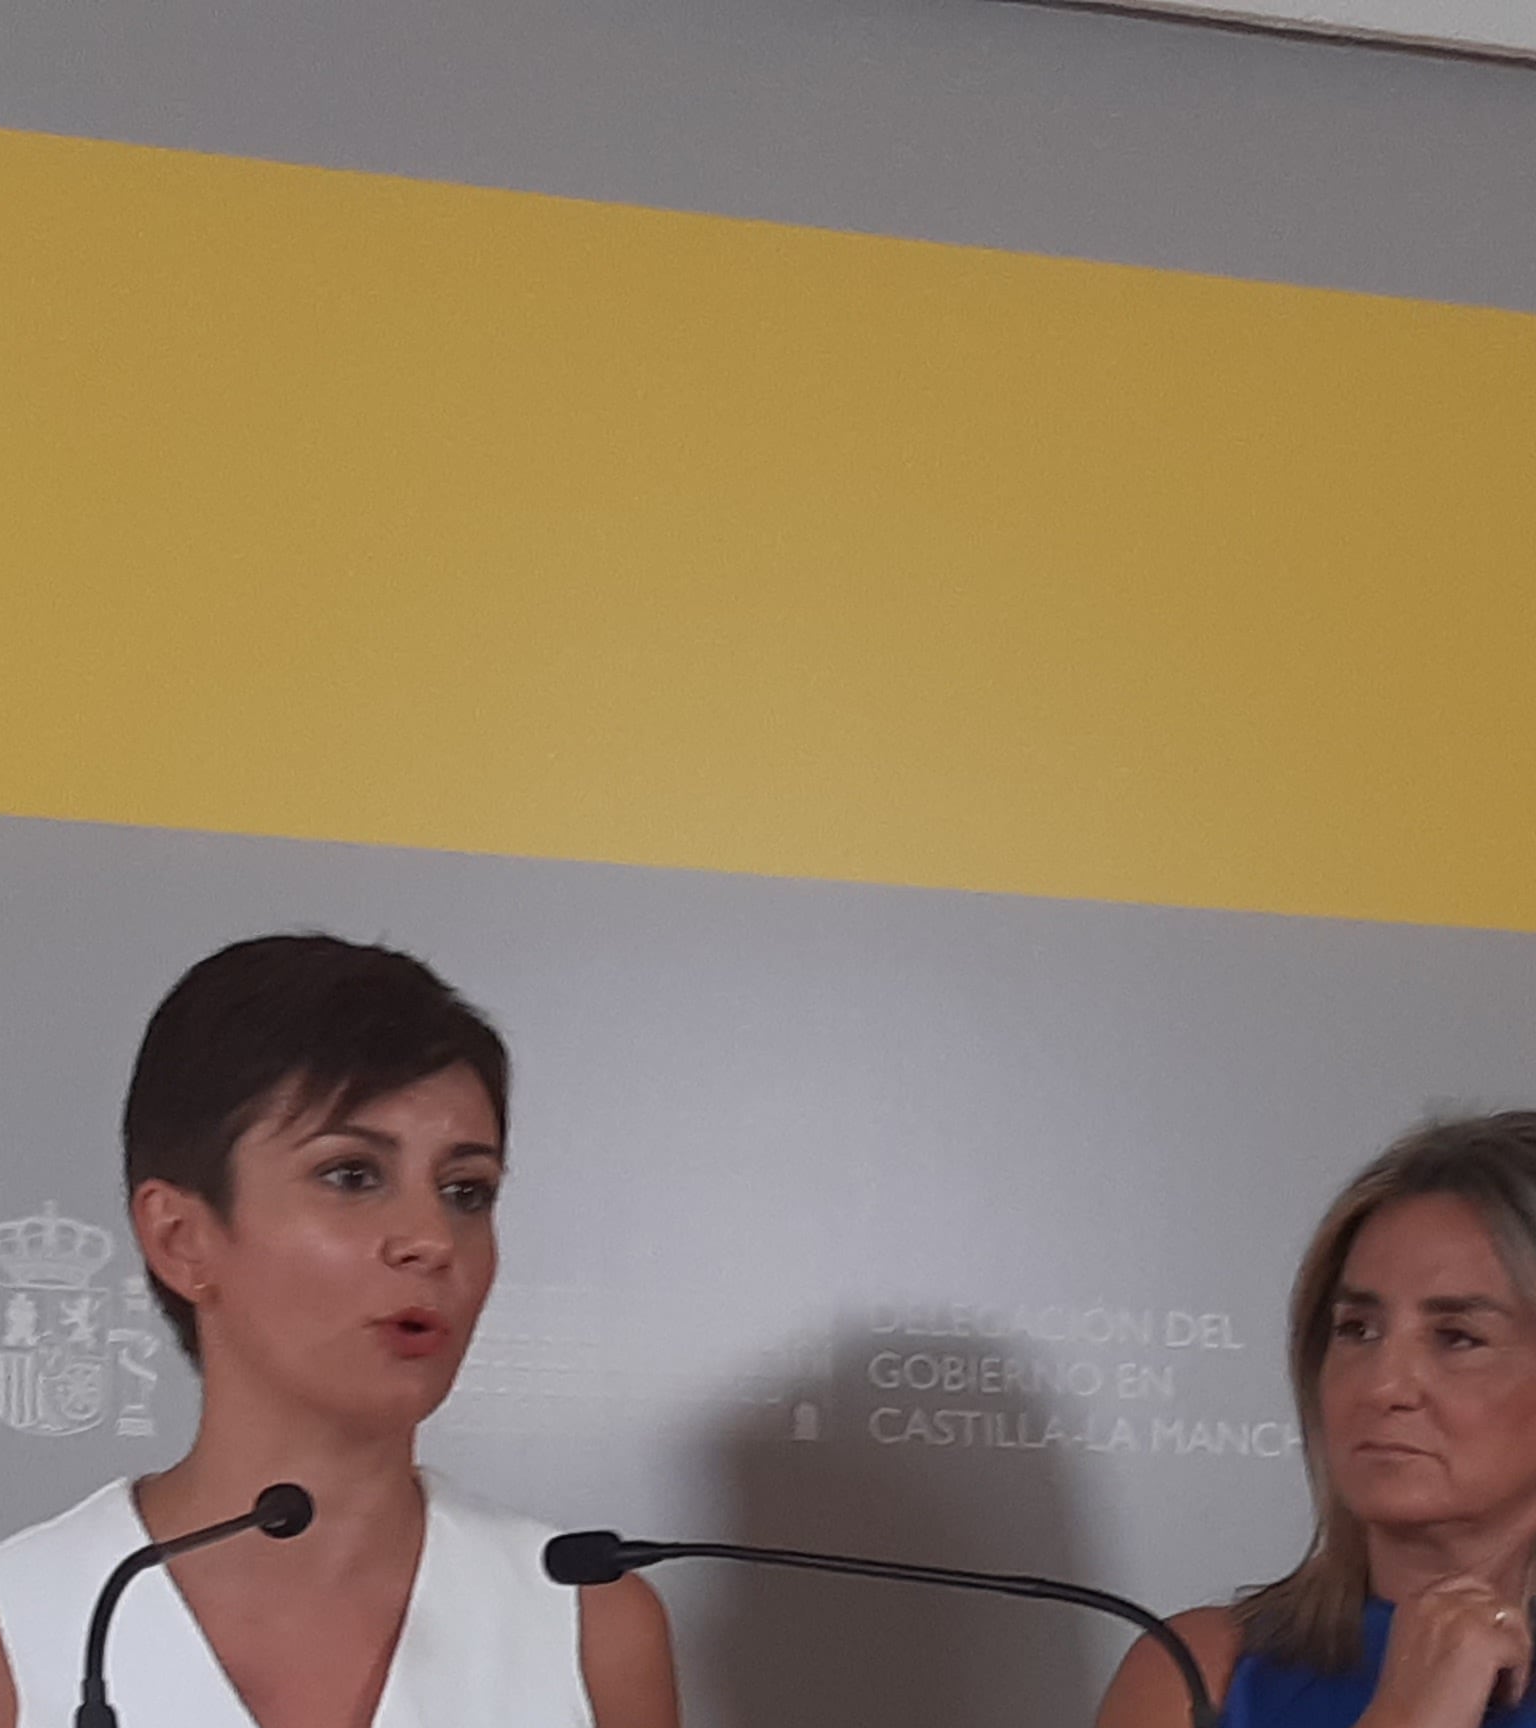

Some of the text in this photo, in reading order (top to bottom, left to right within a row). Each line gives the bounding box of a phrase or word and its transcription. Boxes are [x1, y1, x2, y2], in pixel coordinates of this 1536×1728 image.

[1166, 1309, 1244, 1350] DEL
[868, 1351, 1175, 1400] GOBIERNO EN
[868, 1406, 1304, 1459] CASTILLA-LA MANCH
